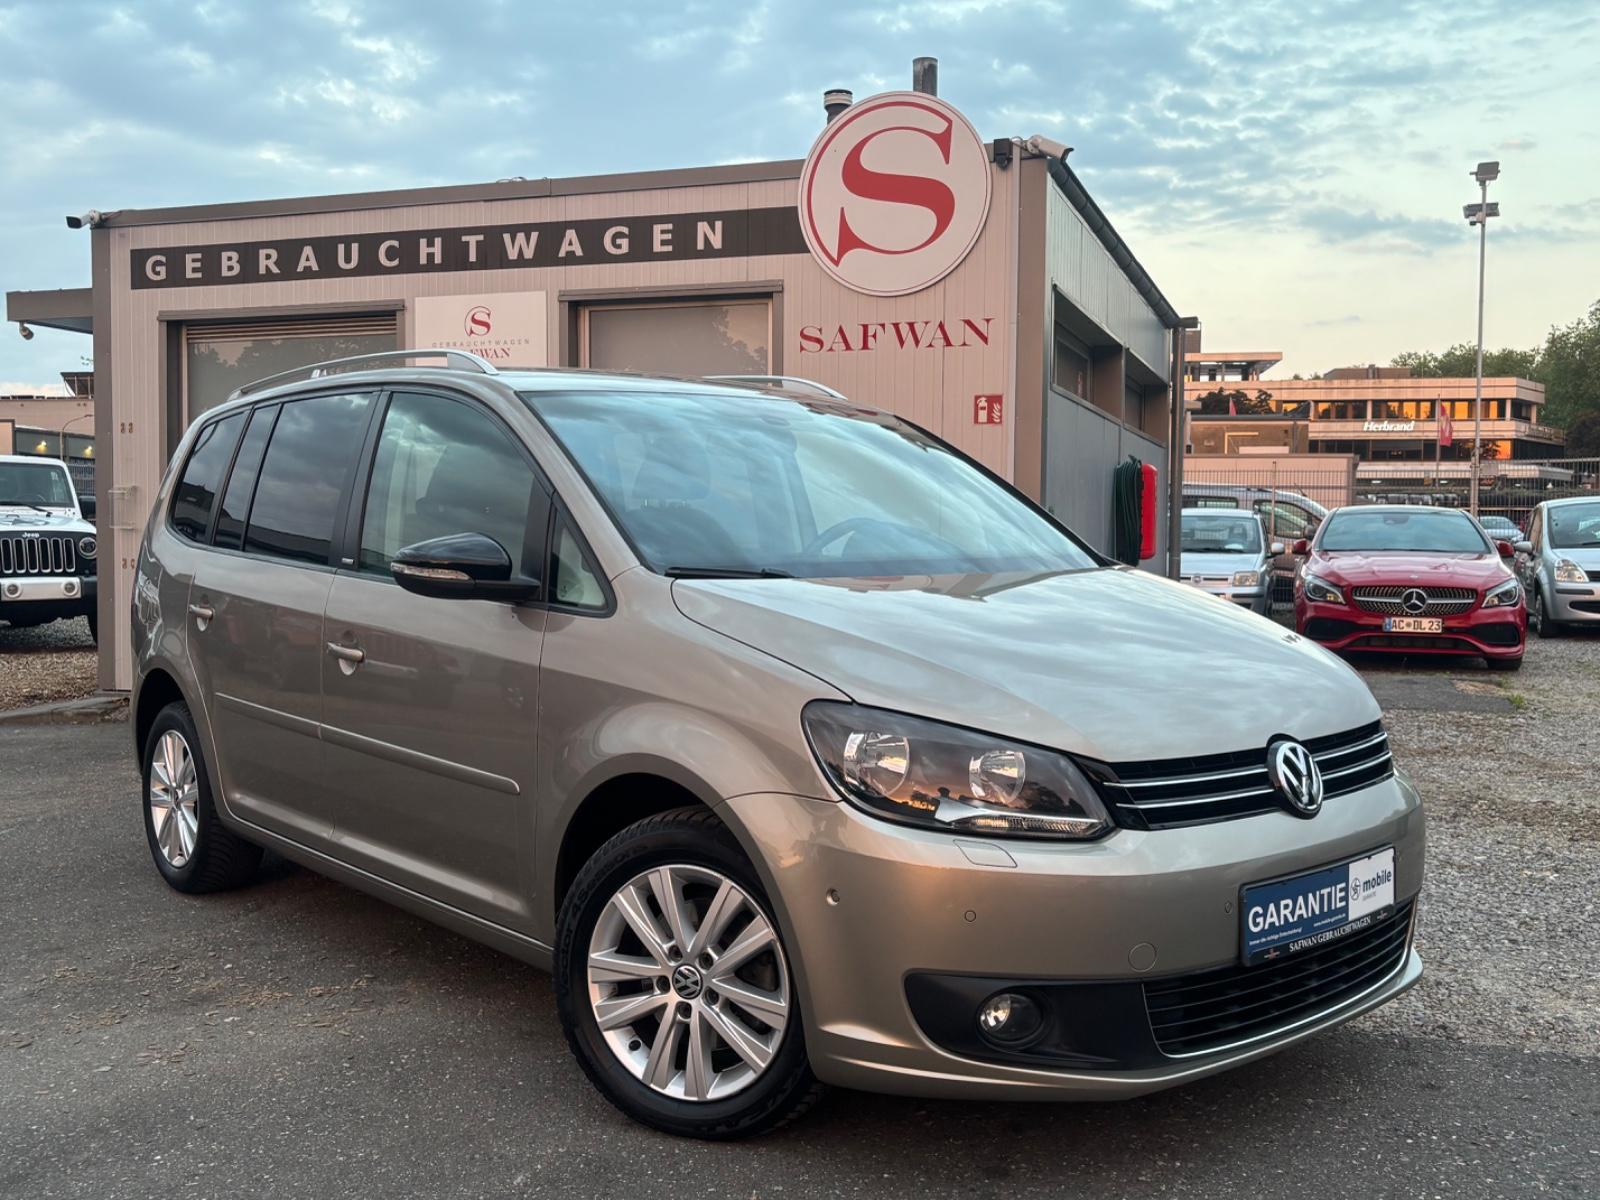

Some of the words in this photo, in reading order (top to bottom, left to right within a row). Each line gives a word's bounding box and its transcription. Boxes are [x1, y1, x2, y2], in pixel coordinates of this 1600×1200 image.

[807, 101, 955, 267] S
[145, 220, 723, 281] GEBRAUCHTWAGEN
[432, 338, 530, 348] GEBRAUCHTWAGEN
[799, 317, 995, 353] SAFWAN
[1363, 421, 1415, 431] Herbrand
[1392, 619, 1404, 630] AC
[1413, 620, 1425, 630] DL
[1428, 620, 1440, 631] 23
[1362, 869, 1392, 893] mobile
[1248, 882, 1347, 933] GARANTIE
[1289, 935, 1318, 953] SAFWAN
